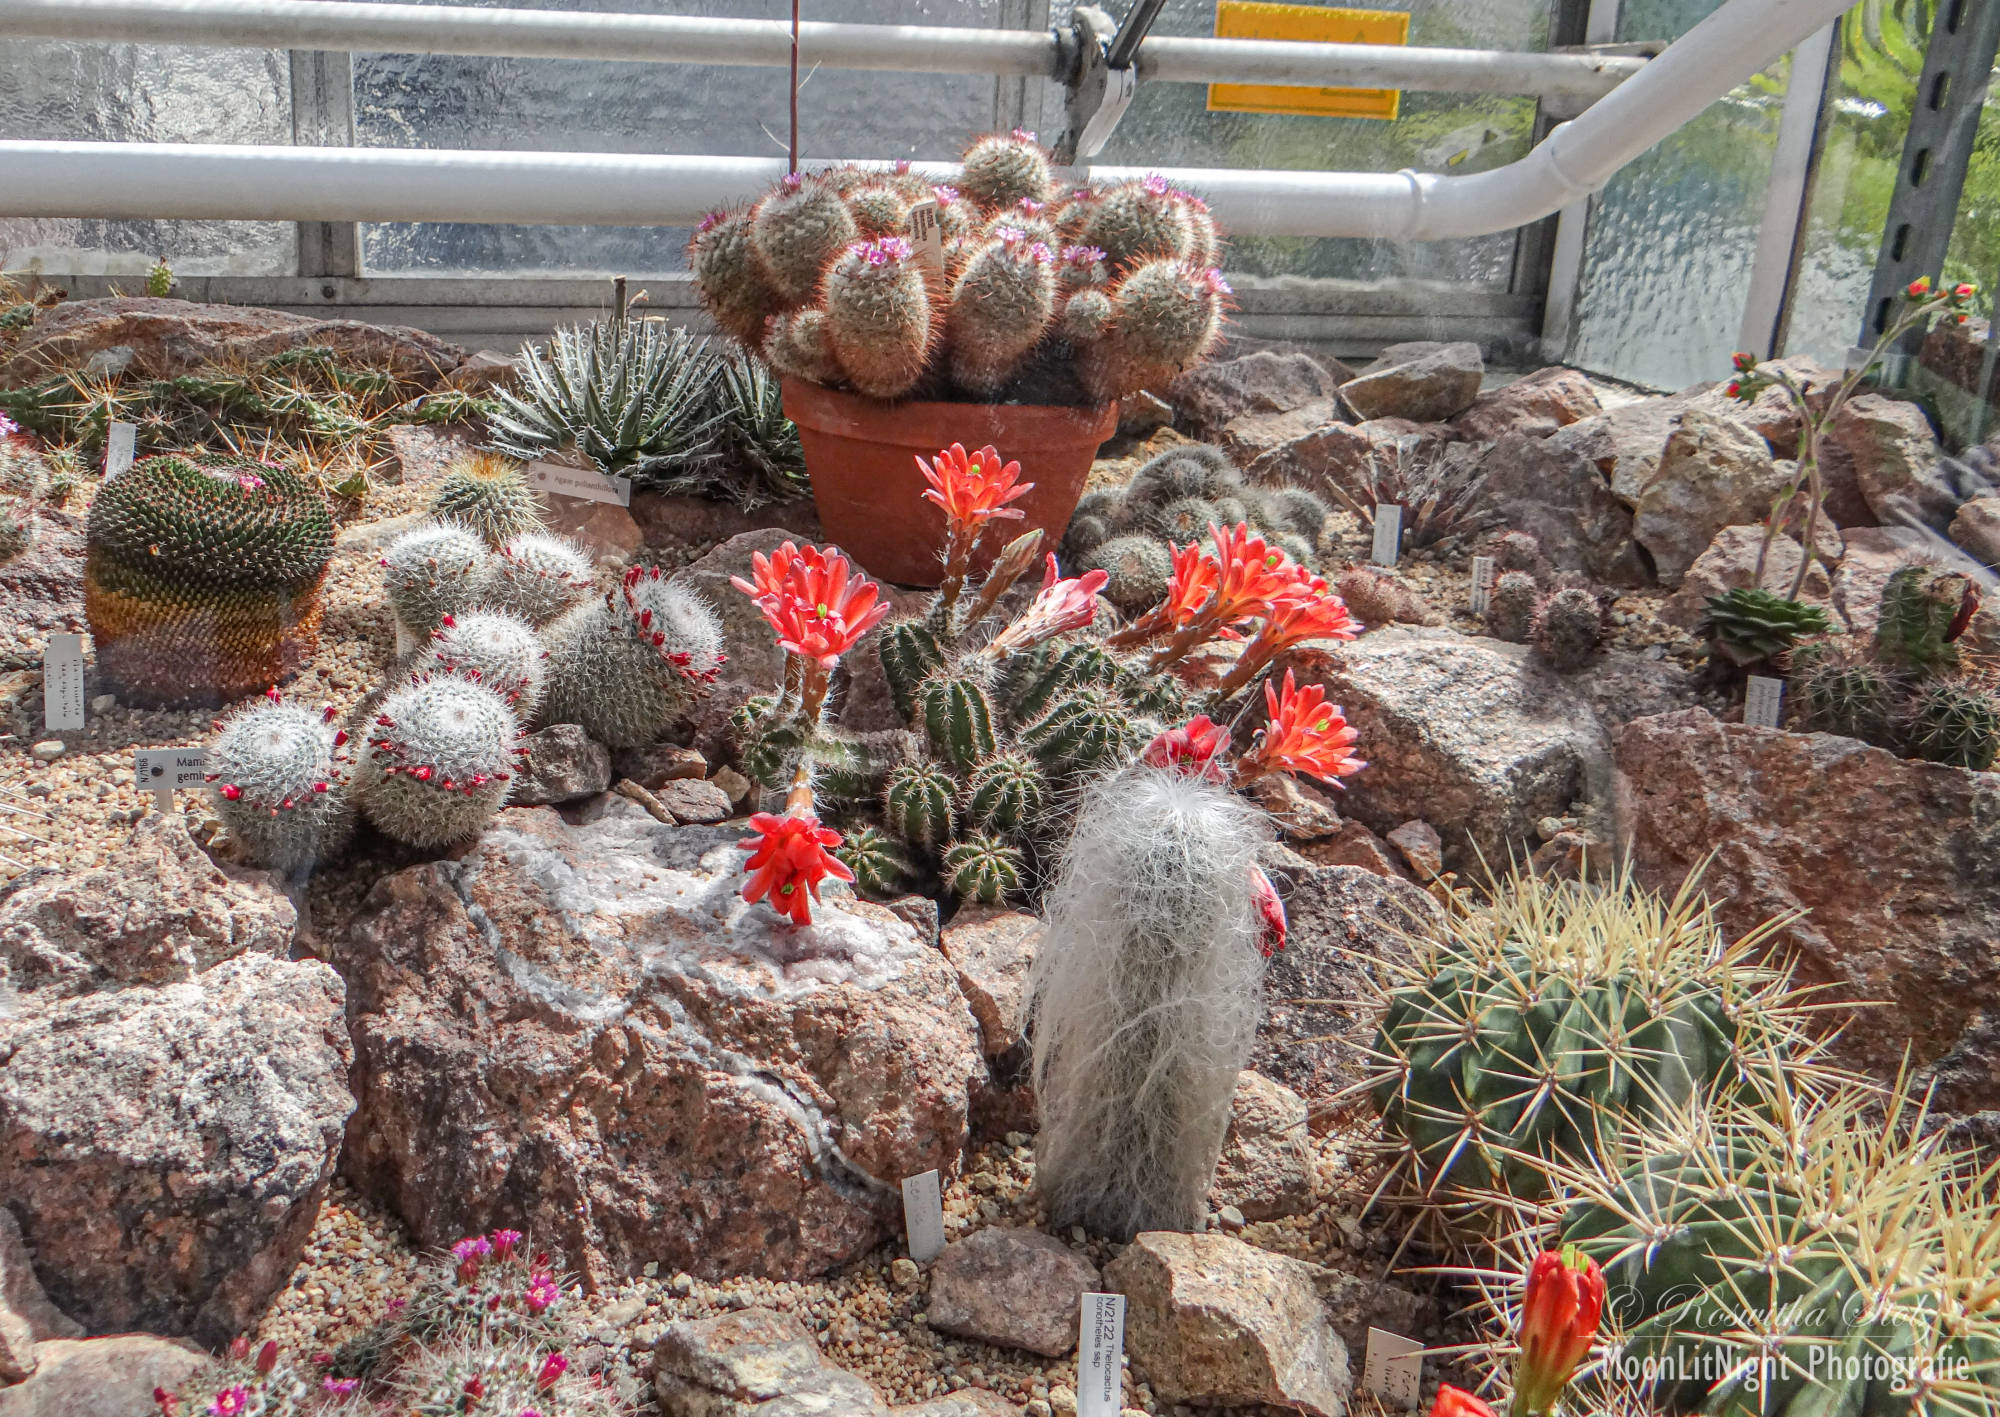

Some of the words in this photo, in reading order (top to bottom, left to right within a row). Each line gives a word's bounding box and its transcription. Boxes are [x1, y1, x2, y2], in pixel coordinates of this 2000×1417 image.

[138, 757, 150, 783] N/1166
[1094, 1296, 1104, 1349] conotheles
[1092, 1350, 1101, 1368] ssp
[1103, 1343, 1115, 1402] Thelocactus
